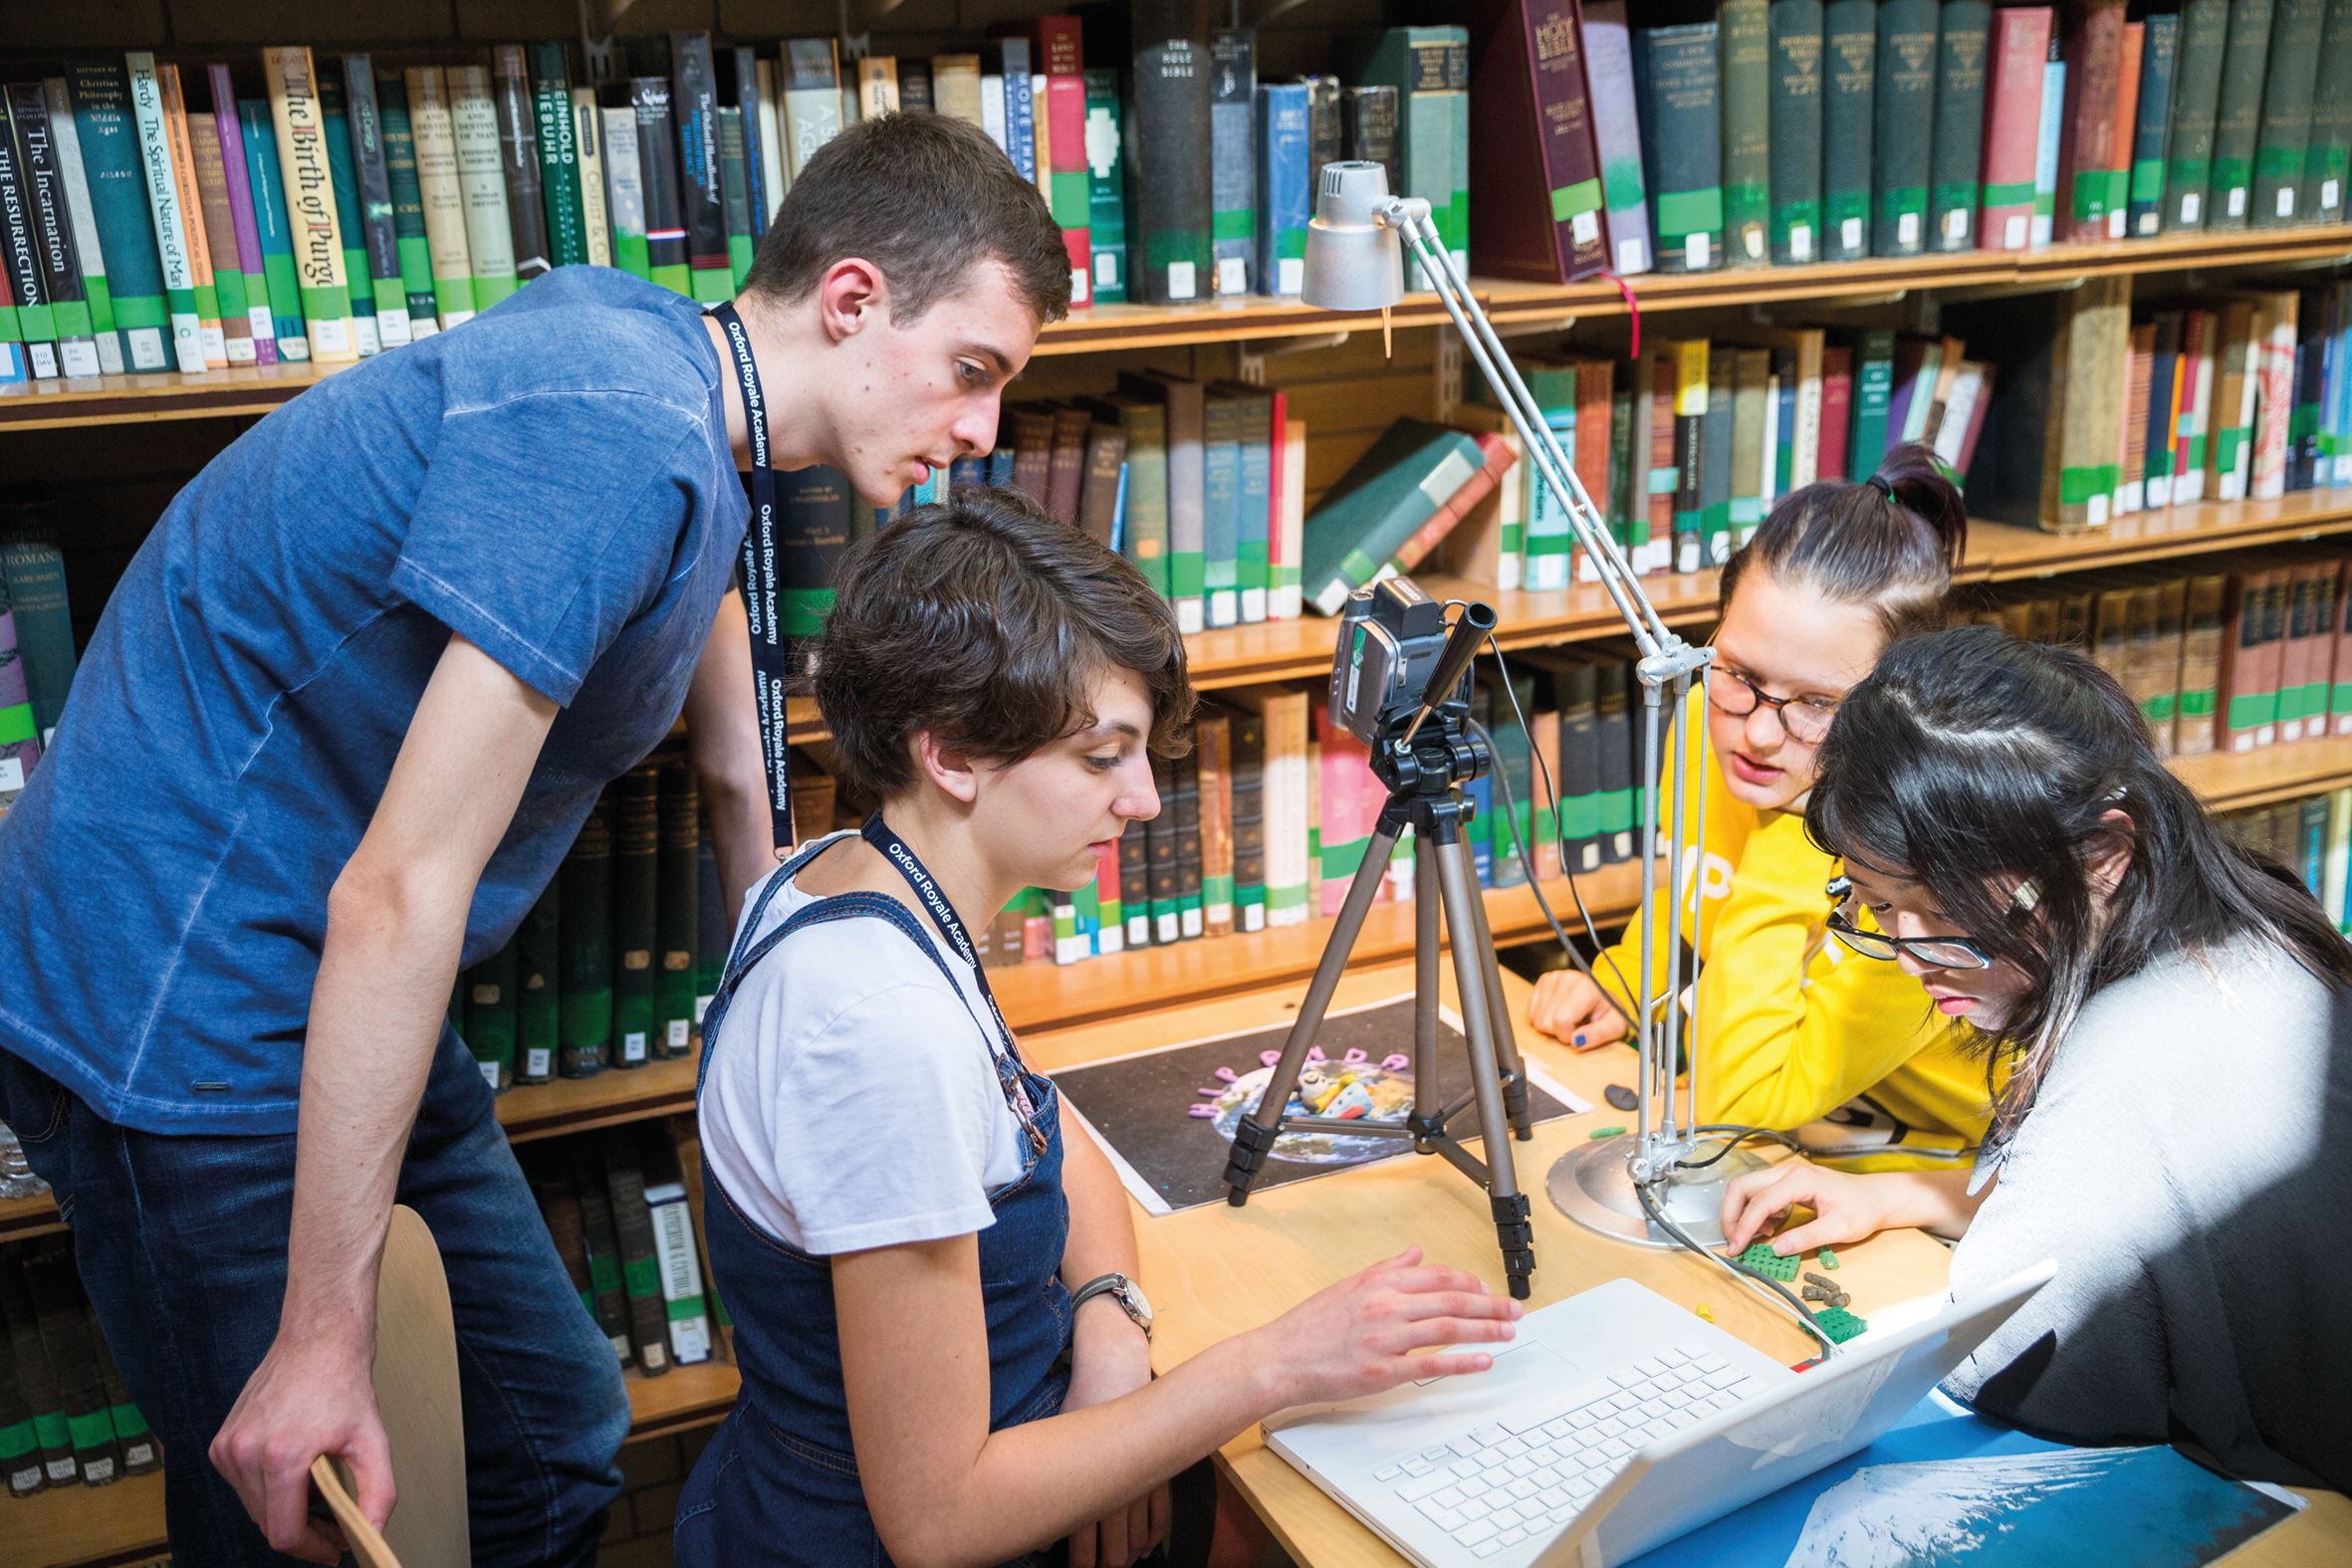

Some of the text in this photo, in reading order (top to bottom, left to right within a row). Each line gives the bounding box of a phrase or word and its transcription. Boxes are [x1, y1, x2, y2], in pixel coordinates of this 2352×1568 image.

[1167, 39, 1188, 50] THE
[1535, 16, 1574, 43] HOLY
[1161, 65, 1194, 78] BIBLE
[1162, 52, 1192, 64] HOLY
[80, 80, 119, 89] Christian
[80, 91, 123, 102] Philosophy
[283, 73, 315, 121] The
[1018, 71, 1032, 126] MORE
[99, 125, 118, 135] Ages
[538, 79, 560, 165] NIEBUHR
[554, 79, 575, 164] REINHOLD
[28, 126, 48, 164] The
[290, 122, 326, 191] Birth
[135, 69, 183, 288] Hardy The Spiritual Nature of Man
[0, 147, 39, 309] THE RESURRECTION
[36, 169, 67, 273] Incarnation
[297, 196, 331, 218] of
[728, 321, 768, 468] Oxford Royale Academy
[7, 550, 58, 565] ROMAN
[743, 550, 758, 591] Royale
[761, 504, 778, 646] Oxford Royale Academy
[750, 592, 762, 635] Oxford
[771, 679, 787, 810] Oxford Royale Academy
[888, 842, 978, 970] Oxford Royale Academy
